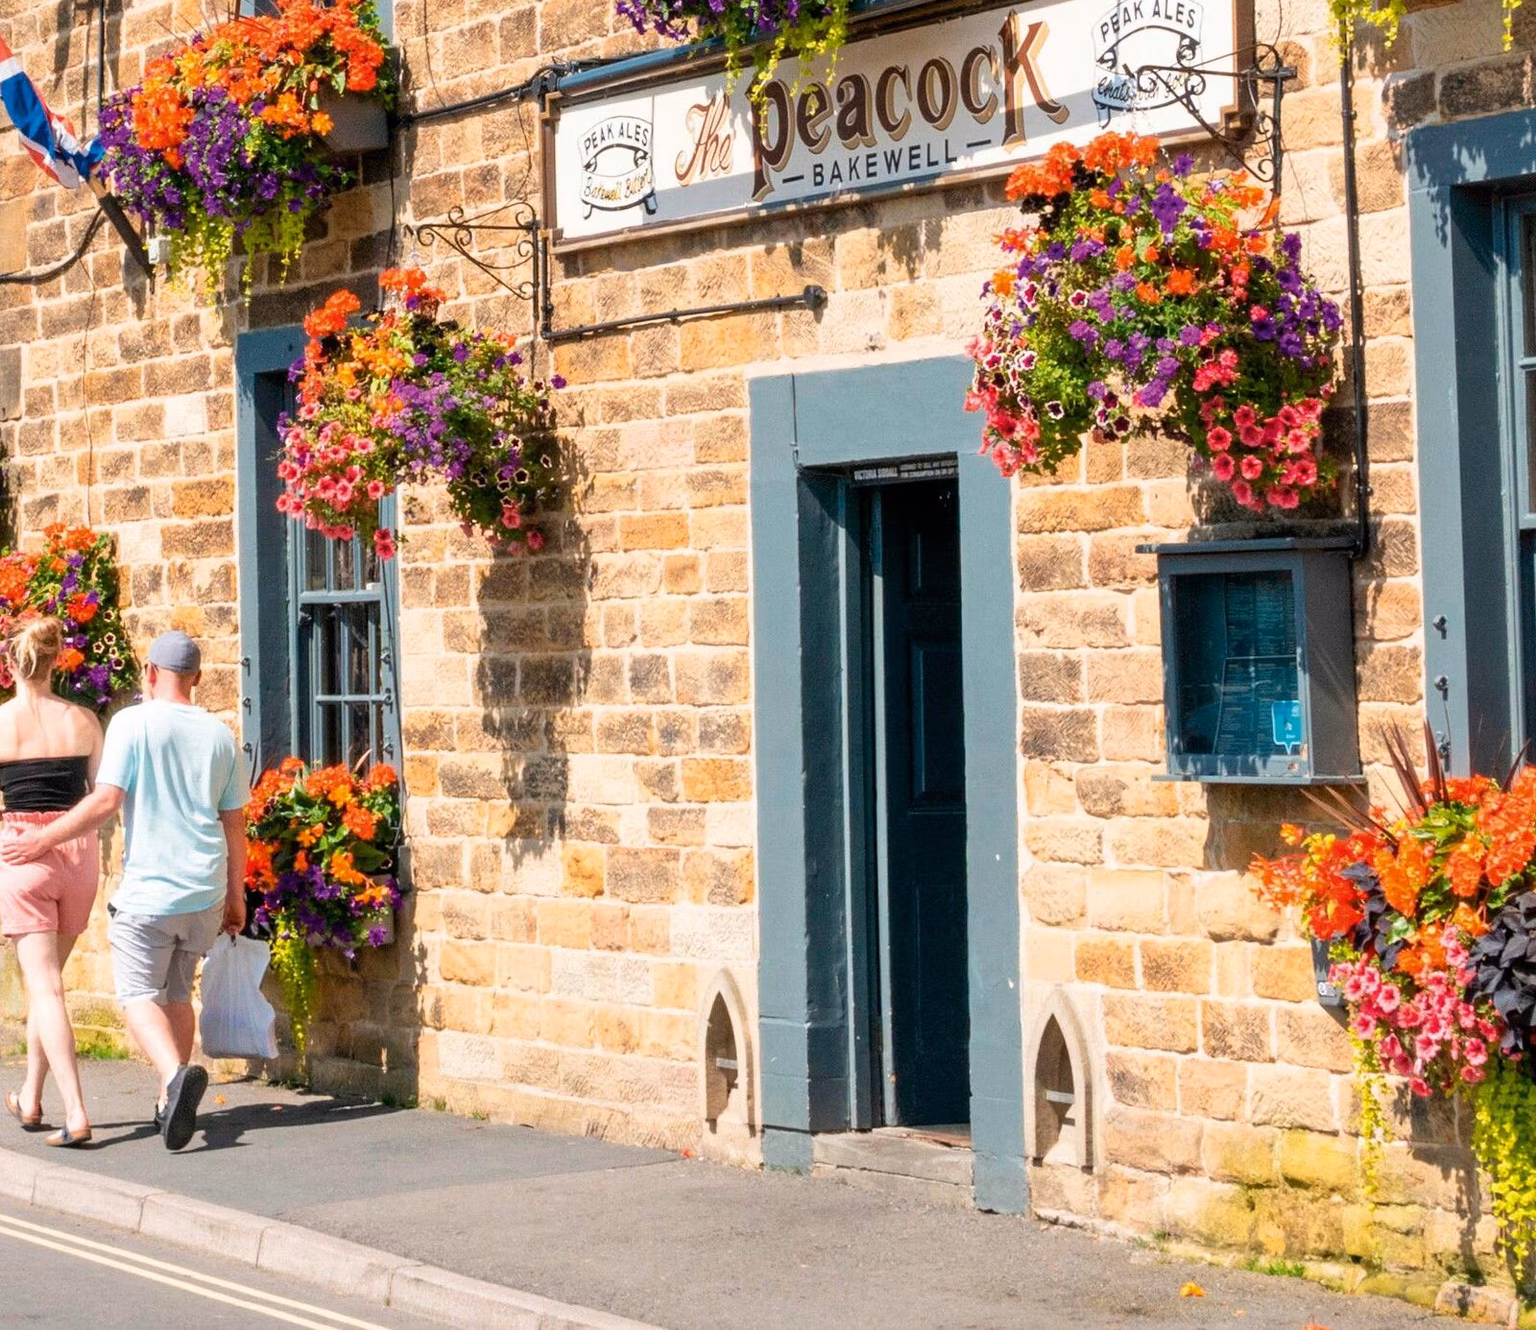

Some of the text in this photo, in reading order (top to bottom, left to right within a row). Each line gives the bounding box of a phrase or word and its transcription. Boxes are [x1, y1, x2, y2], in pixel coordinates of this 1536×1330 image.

[1100, 0, 1144, 43] PEAK
[583, 121, 650, 156] PEAK ALES
[675, 92, 735, 187] The
[813, 139, 958, 187] BAKEWELL
